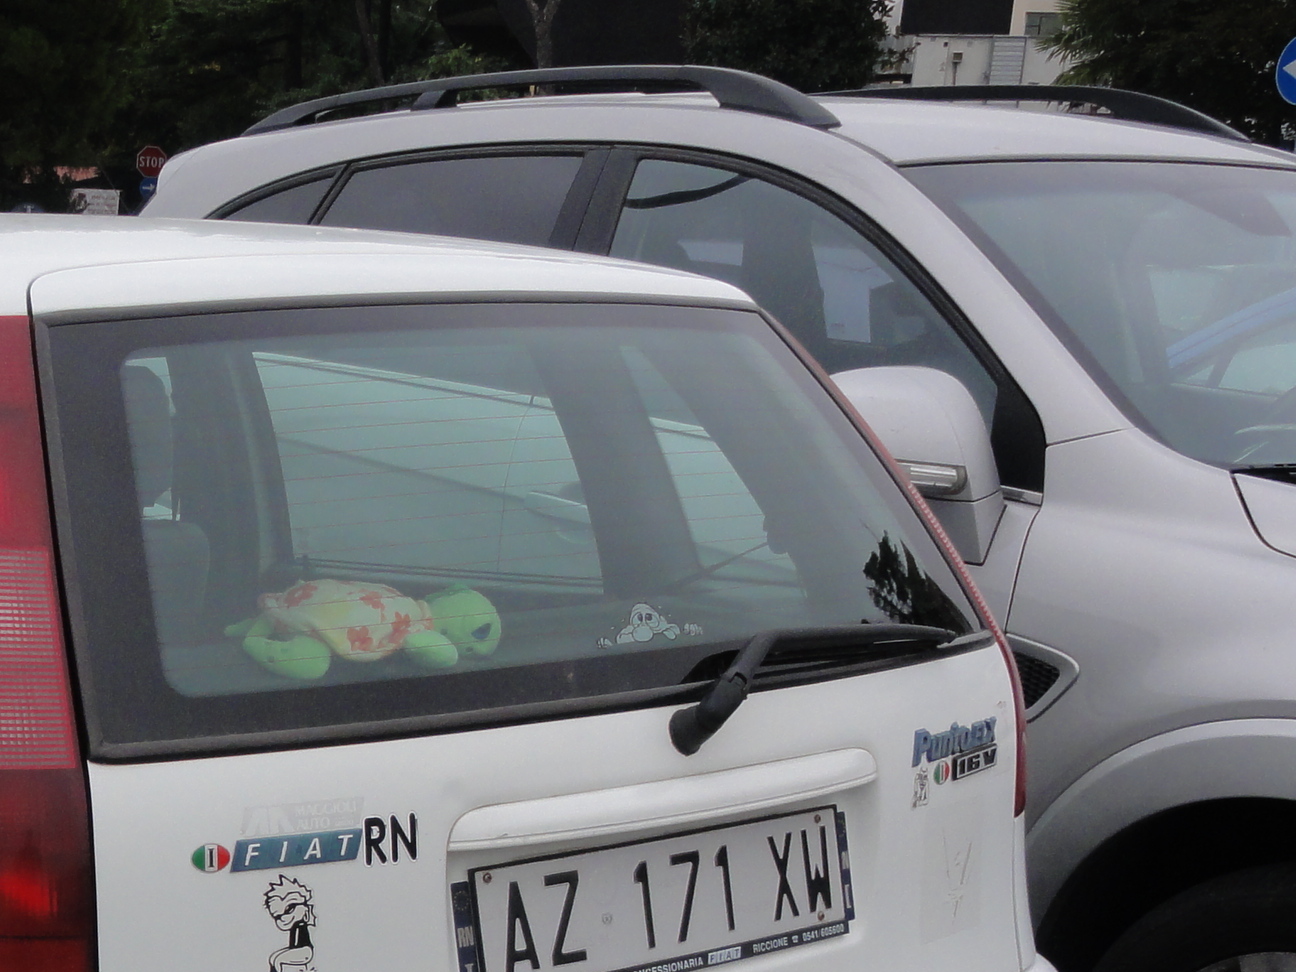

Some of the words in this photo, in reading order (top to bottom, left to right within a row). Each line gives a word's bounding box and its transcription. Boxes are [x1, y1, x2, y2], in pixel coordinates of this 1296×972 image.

[139, 156, 165, 168] STOP
[244, 834, 354, 867] FIAT
[363, 812, 417, 866] RN
[633, 844, 737, 949] 171
[766, 824, 833, 921] XW
[457, 925, 475, 948] RN
[708, 946, 741, 965] FIAT
[752, 936, 789, 954] RICCIONE
